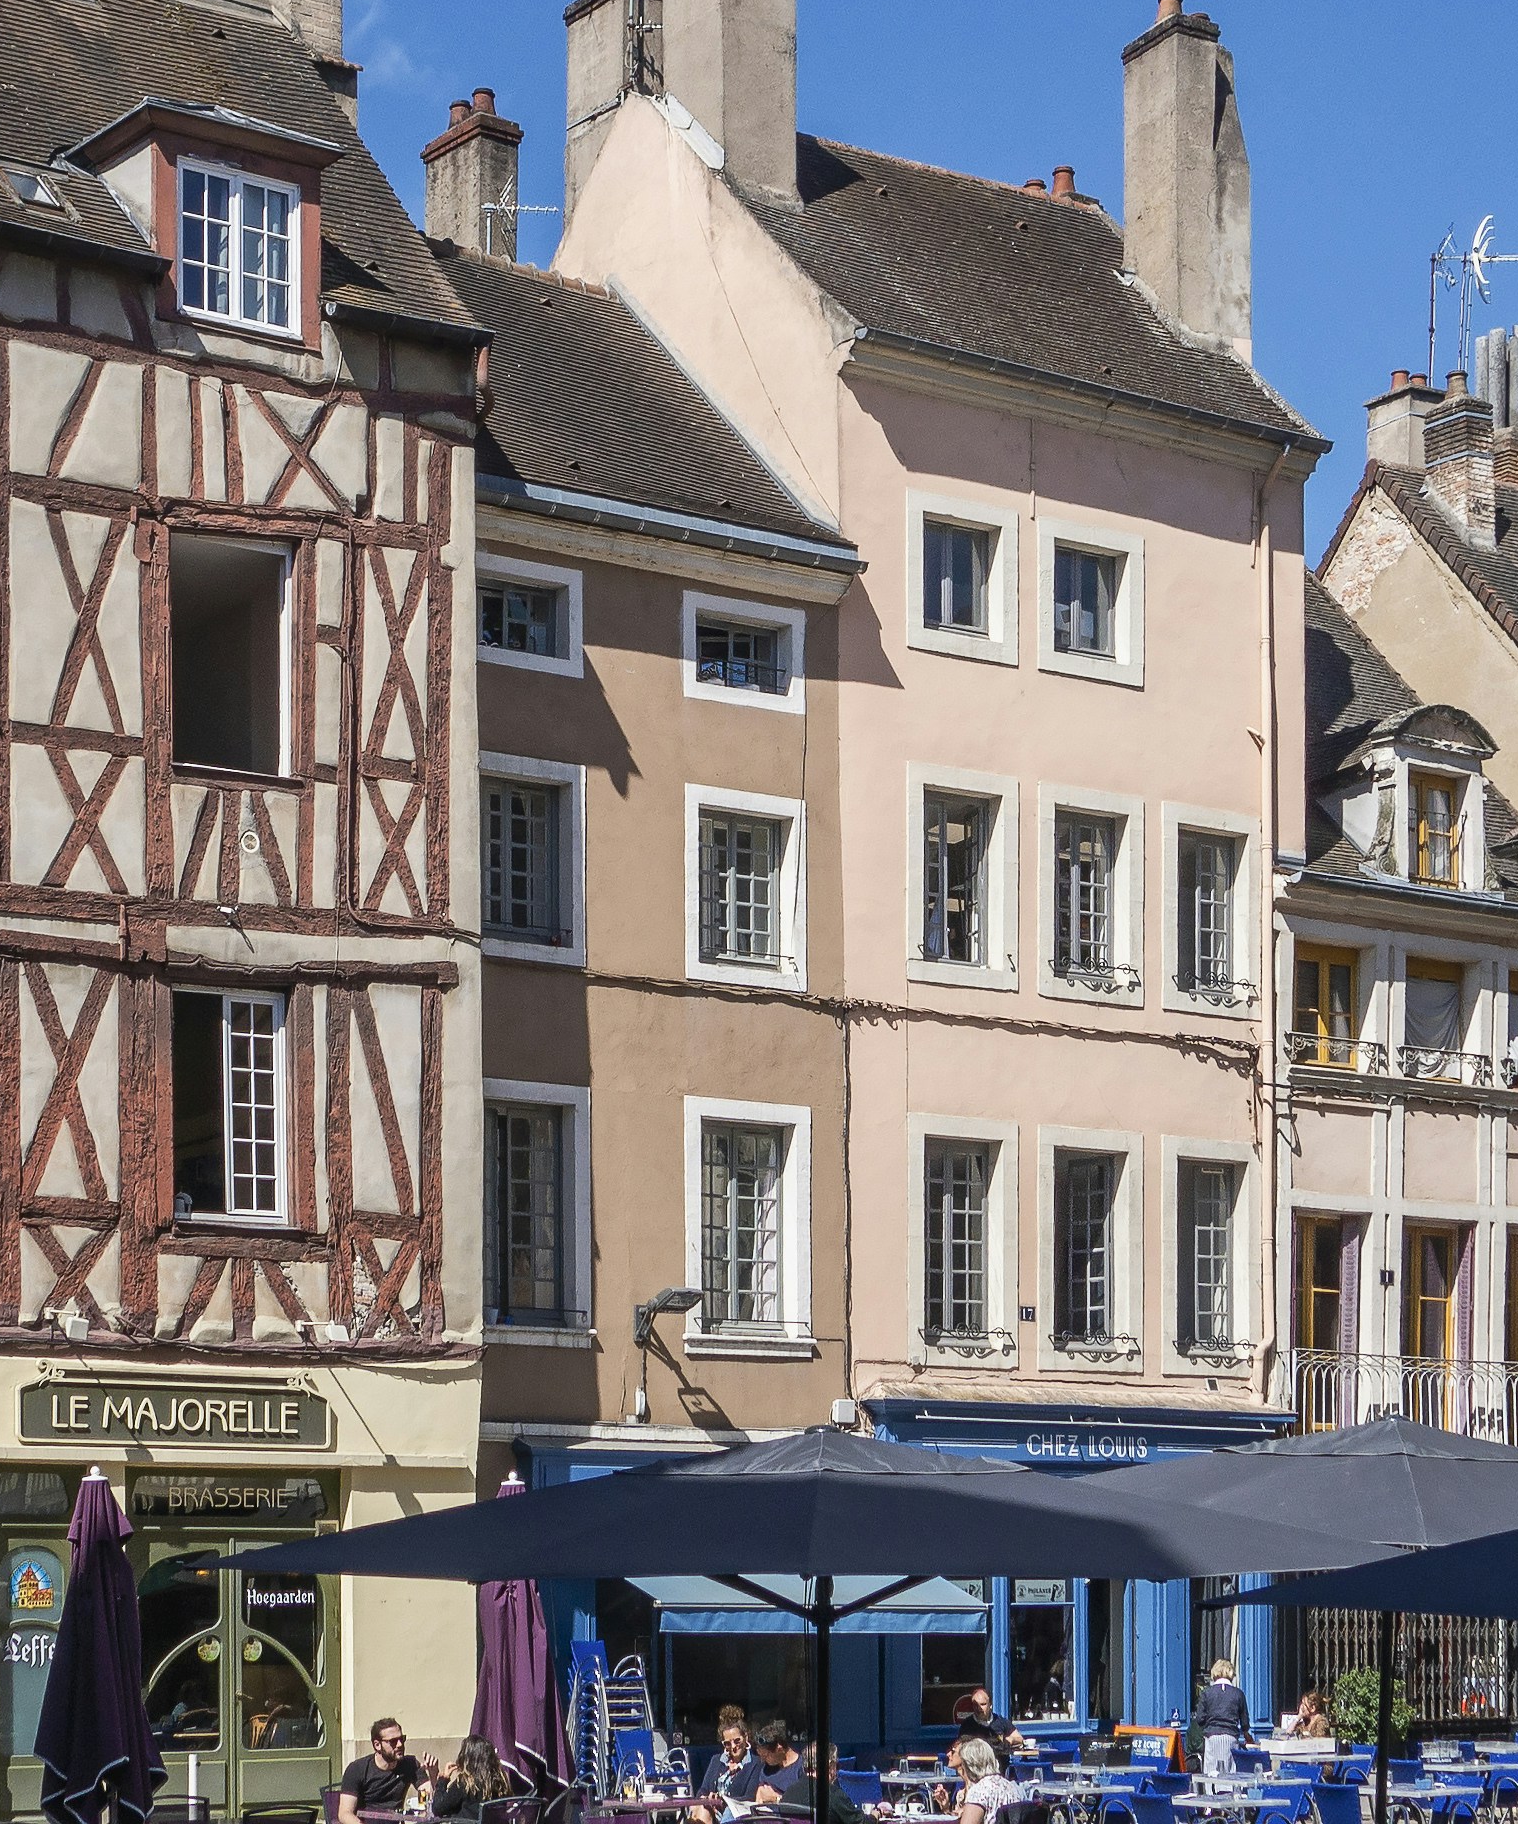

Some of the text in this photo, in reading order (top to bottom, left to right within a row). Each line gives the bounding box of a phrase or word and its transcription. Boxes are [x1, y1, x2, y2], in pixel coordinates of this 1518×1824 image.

[1022, 1307, 1033, 1320] 17
[51, 1394, 300, 1434] LE MAJORELLE
[1026, 1434, 1148, 1459] CHEZ LOUIS
[168, 1486, 288, 1509] BRASSERIE
[246, 1588, 316, 1608] Hoegaarden
